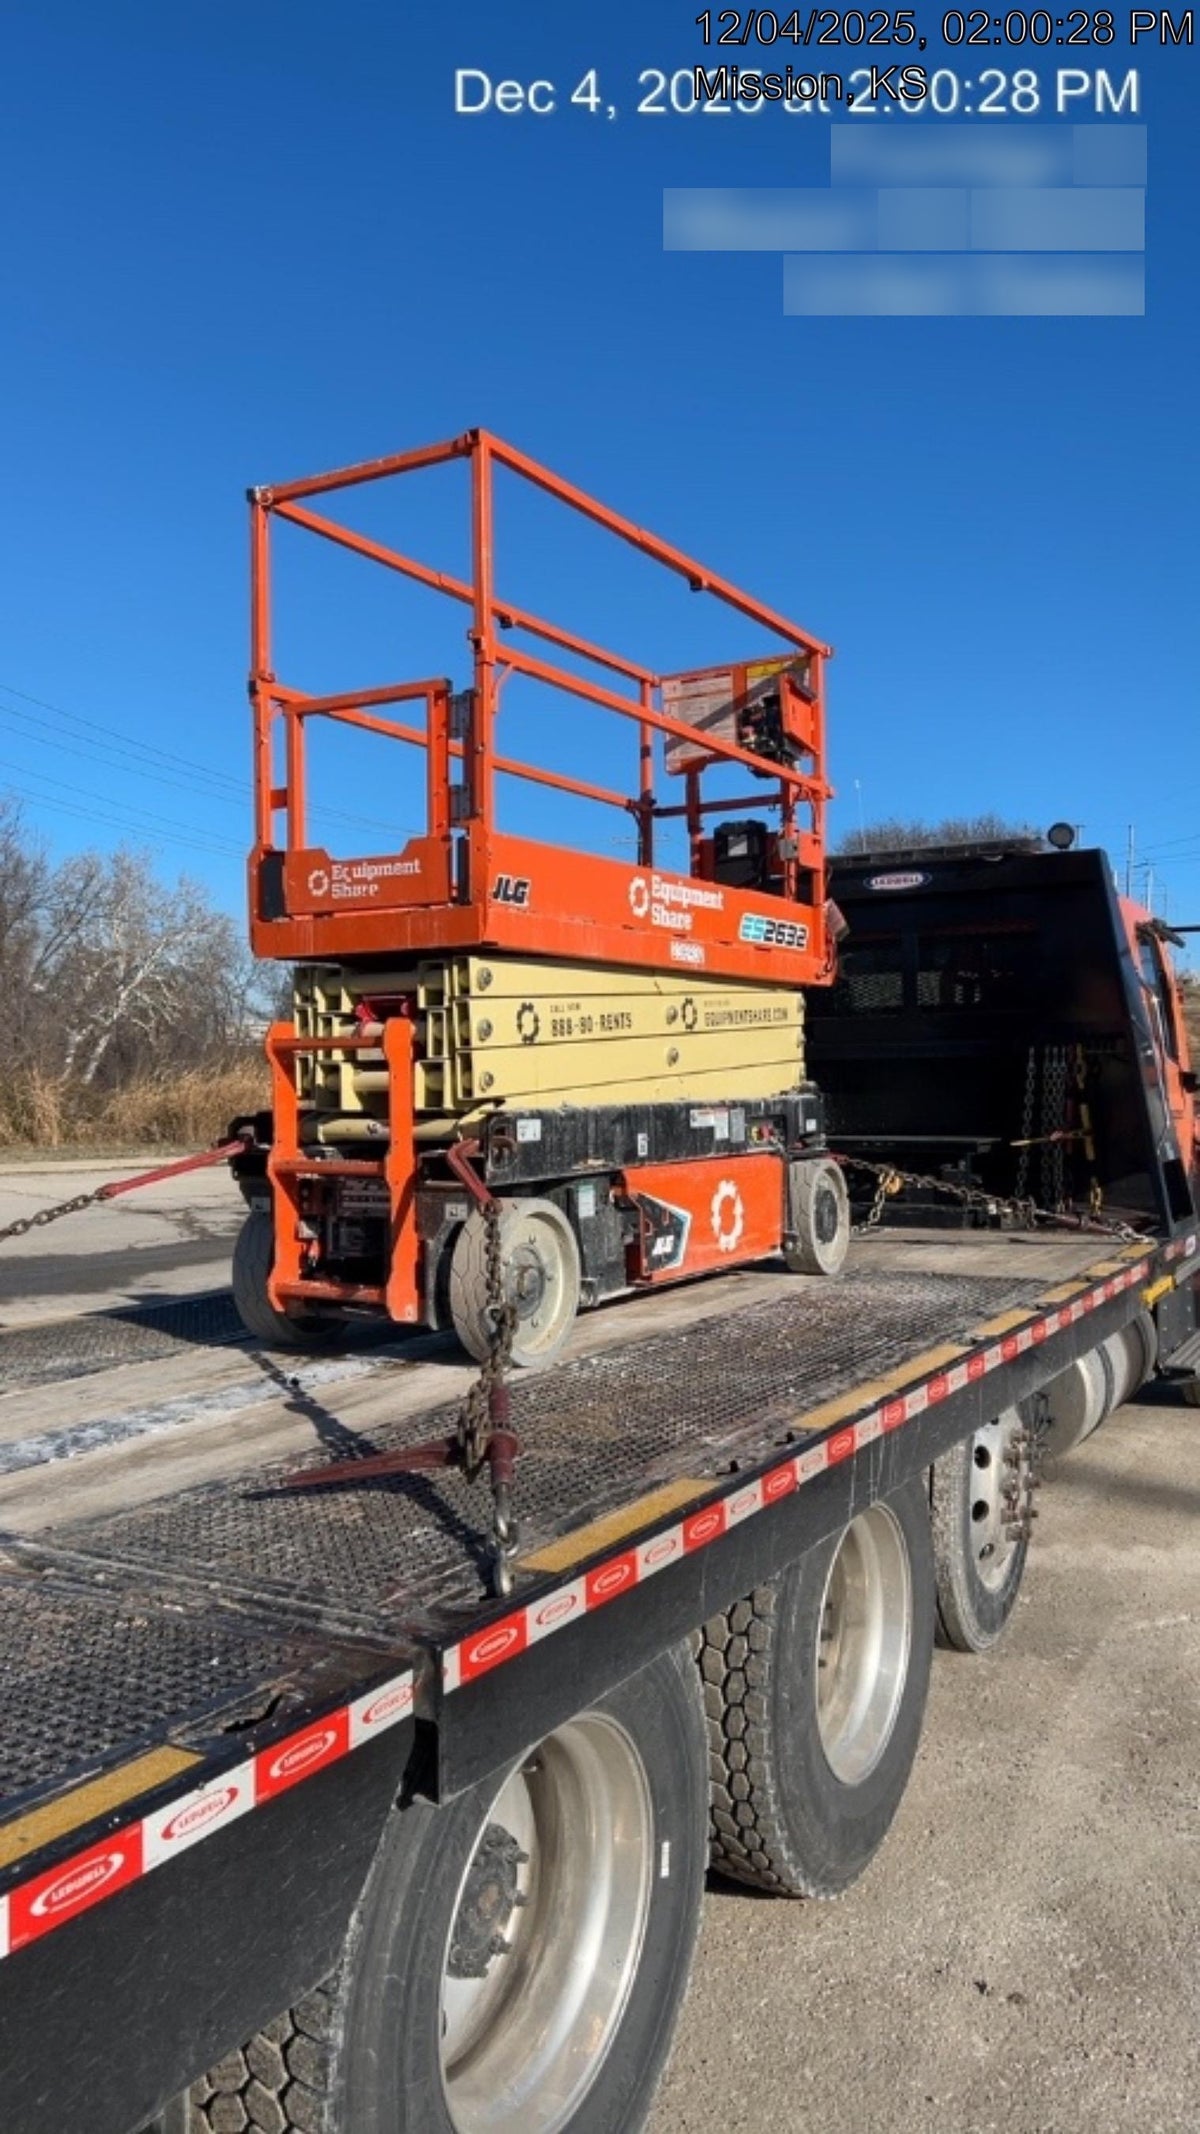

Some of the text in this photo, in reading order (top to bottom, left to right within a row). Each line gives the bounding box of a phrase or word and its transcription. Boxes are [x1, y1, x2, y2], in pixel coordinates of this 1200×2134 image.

[331, 859, 421, 882] Equipment
[331, 883, 378, 899] Share
[492, 876, 529, 904] JLG
[651, 875, 724, 911] Equipment
[651, 903, 693, 931] Share
[741, 915, 807, 948] ES2632
